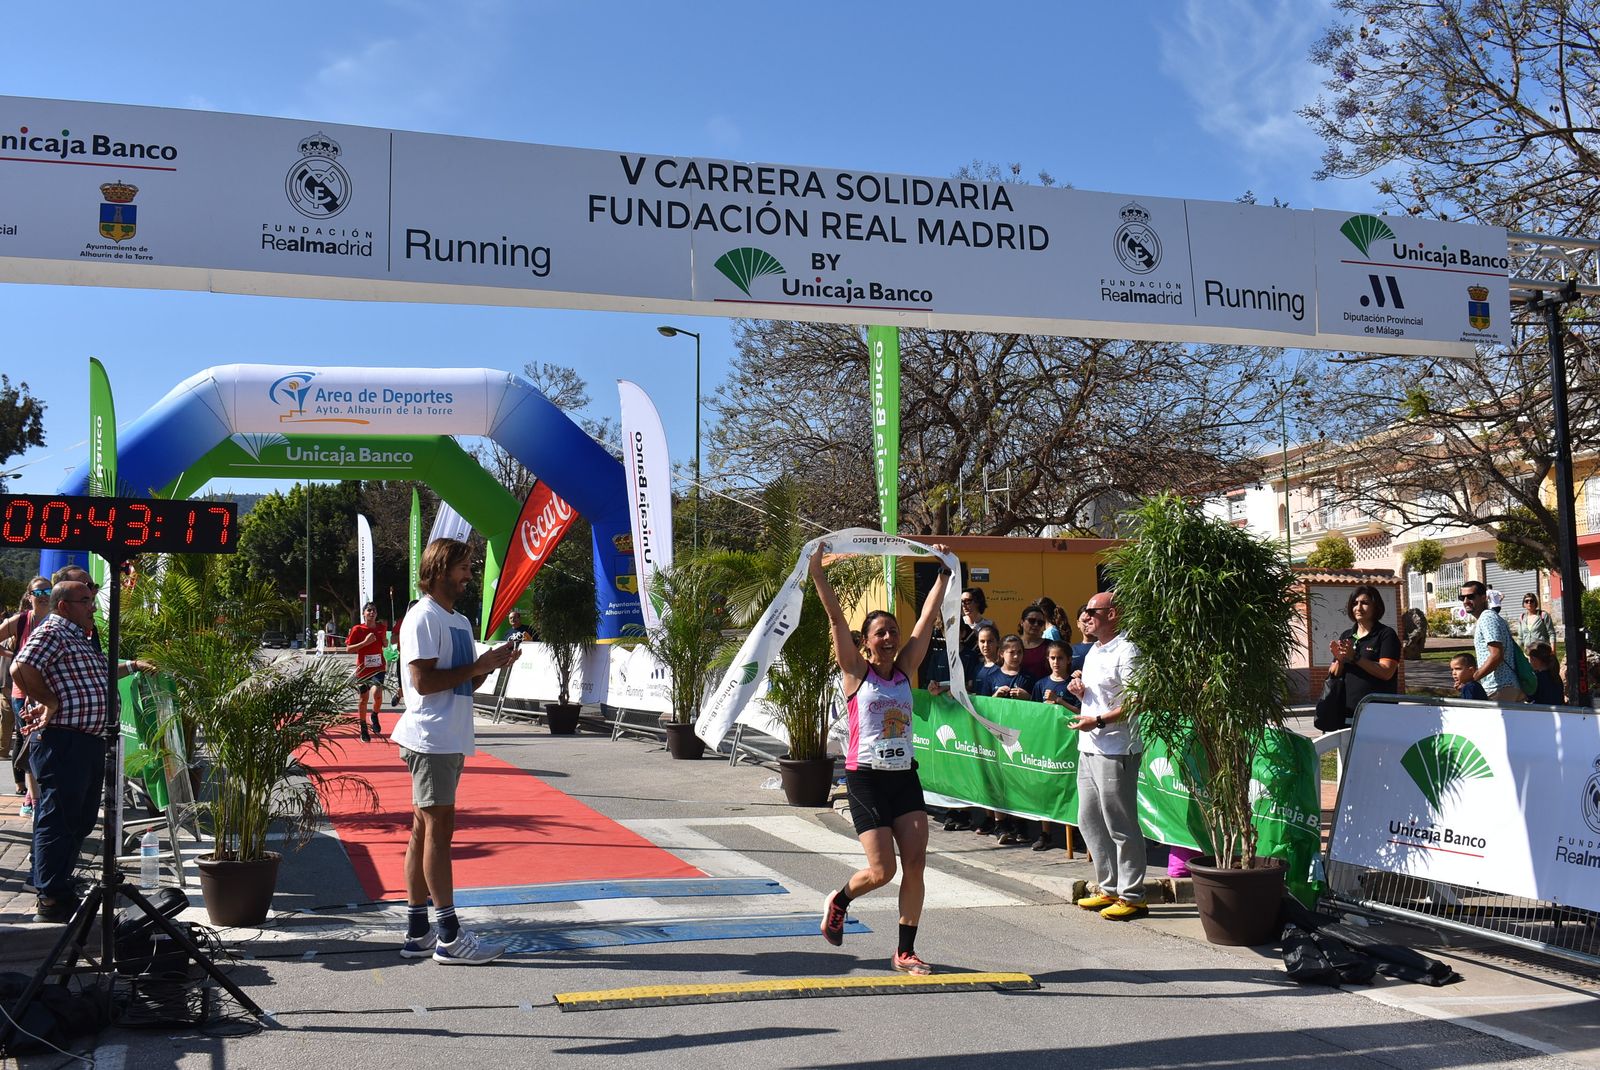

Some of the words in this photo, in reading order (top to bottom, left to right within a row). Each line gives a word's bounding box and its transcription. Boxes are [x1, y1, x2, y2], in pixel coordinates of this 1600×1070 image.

[92, 134, 178, 160] Banco
[620, 155, 647, 185] V
[654, 159, 826, 199] CARRERA
[836, 173, 1014, 212] SOLIDARIA
[262, 223, 373, 238] FUNDACIÓN
[588, 194, 808, 238] FUNDACIÓN
[821, 211, 907, 244] REAL
[918, 218, 1050, 251] MADRID
[86, 243, 138, 252] Ayuntamiento
[261, 233, 372, 257] Realmadrid
[406, 228, 552, 277] Running
[80, 251, 112, 259] Alhaurín
[812, 252, 841, 271] BY
[1392, 242, 1458, 268] Unicaja
[1460, 249, 1509, 270] Banco
[782, 276, 866, 304] Unicaja
[869, 282, 933, 302] Banco
[1100, 278, 1182, 290] FUNDACIÓN
[1101, 287, 1182, 305] Realmadrid
[1204, 280, 1305, 321] Running
[1343, 312, 1386, 324] Diputación
[1386, 315, 1424, 326] Provincial
[1364, 325, 1376, 334] de
[1376, 325, 1404, 337] Málaga
[358, 388, 378, 403] de
[383, 388, 453, 406] Deportes
[316, 406, 342, 416] Ayto.
[347, 406, 392, 415] Alhaurín
[396, 406, 408, 415] de
[413, 406, 422, 415] la
[426, 406, 453, 416] Torre
[286, 445, 356, 466] Unicaja
[360, 448, 414, 463] Banco
[852, 537, 878, 545] Banco
[715, 679, 738, 711] Unicaja
[912, 734, 930, 745] Banco
[878, 748, 905, 758] 136
[1020, 753, 1049, 770] Unicaja
[1048, 758, 1075, 769] Banco
[1389, 820, 1442, 844] Unicaja
[1444, 828, 1486, 849] Banco
